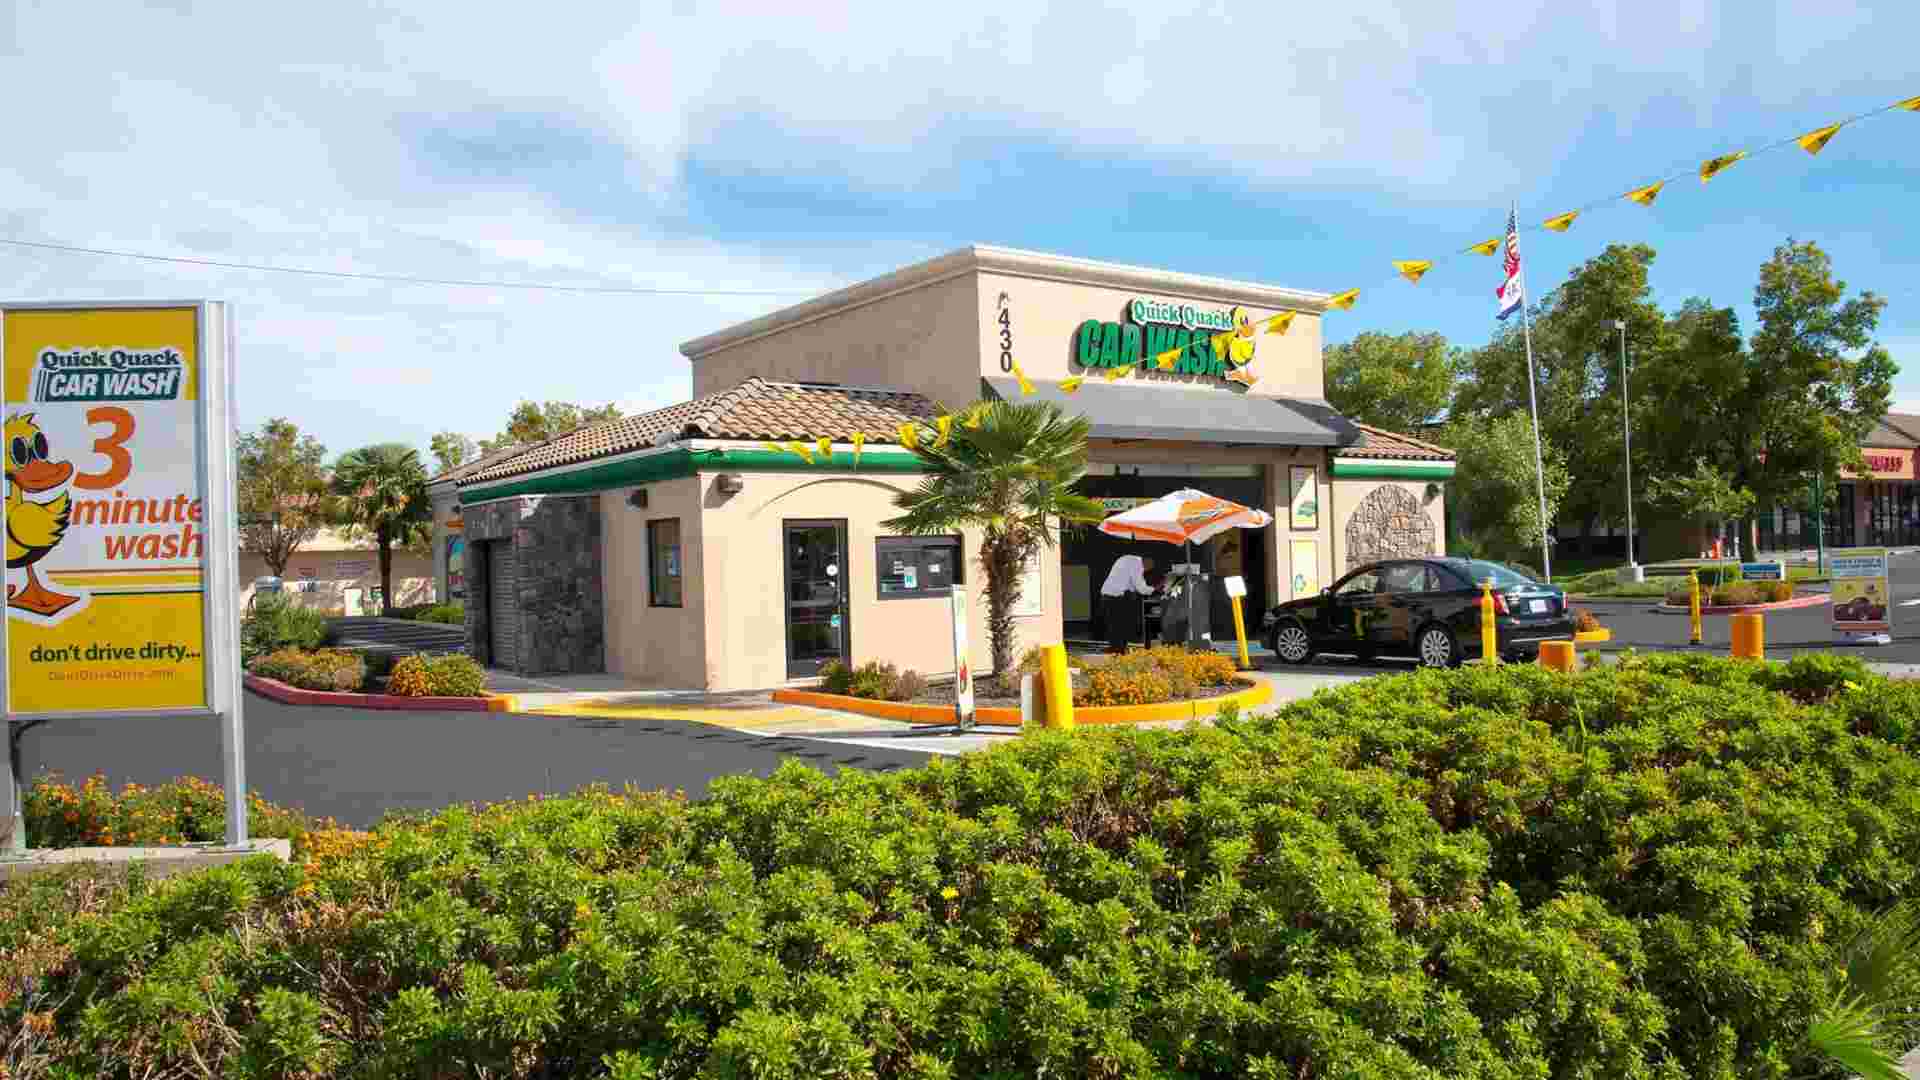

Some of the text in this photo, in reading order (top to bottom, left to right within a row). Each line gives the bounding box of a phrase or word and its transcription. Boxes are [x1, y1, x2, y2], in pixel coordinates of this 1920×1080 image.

[1134, 300, 1233, 329] Quick Quack
[1078, 319, 1141, 368] CAR
[41, 350, 180, 371] Quick Quack
[50, 369, 177, 397] CAR WASH
[72, 406, 136, 490] 3
[71, 490, 203, 525] minute
[104, 524, 204, 560] wash
[30, 641, 200, 663] don't drive dirty...
